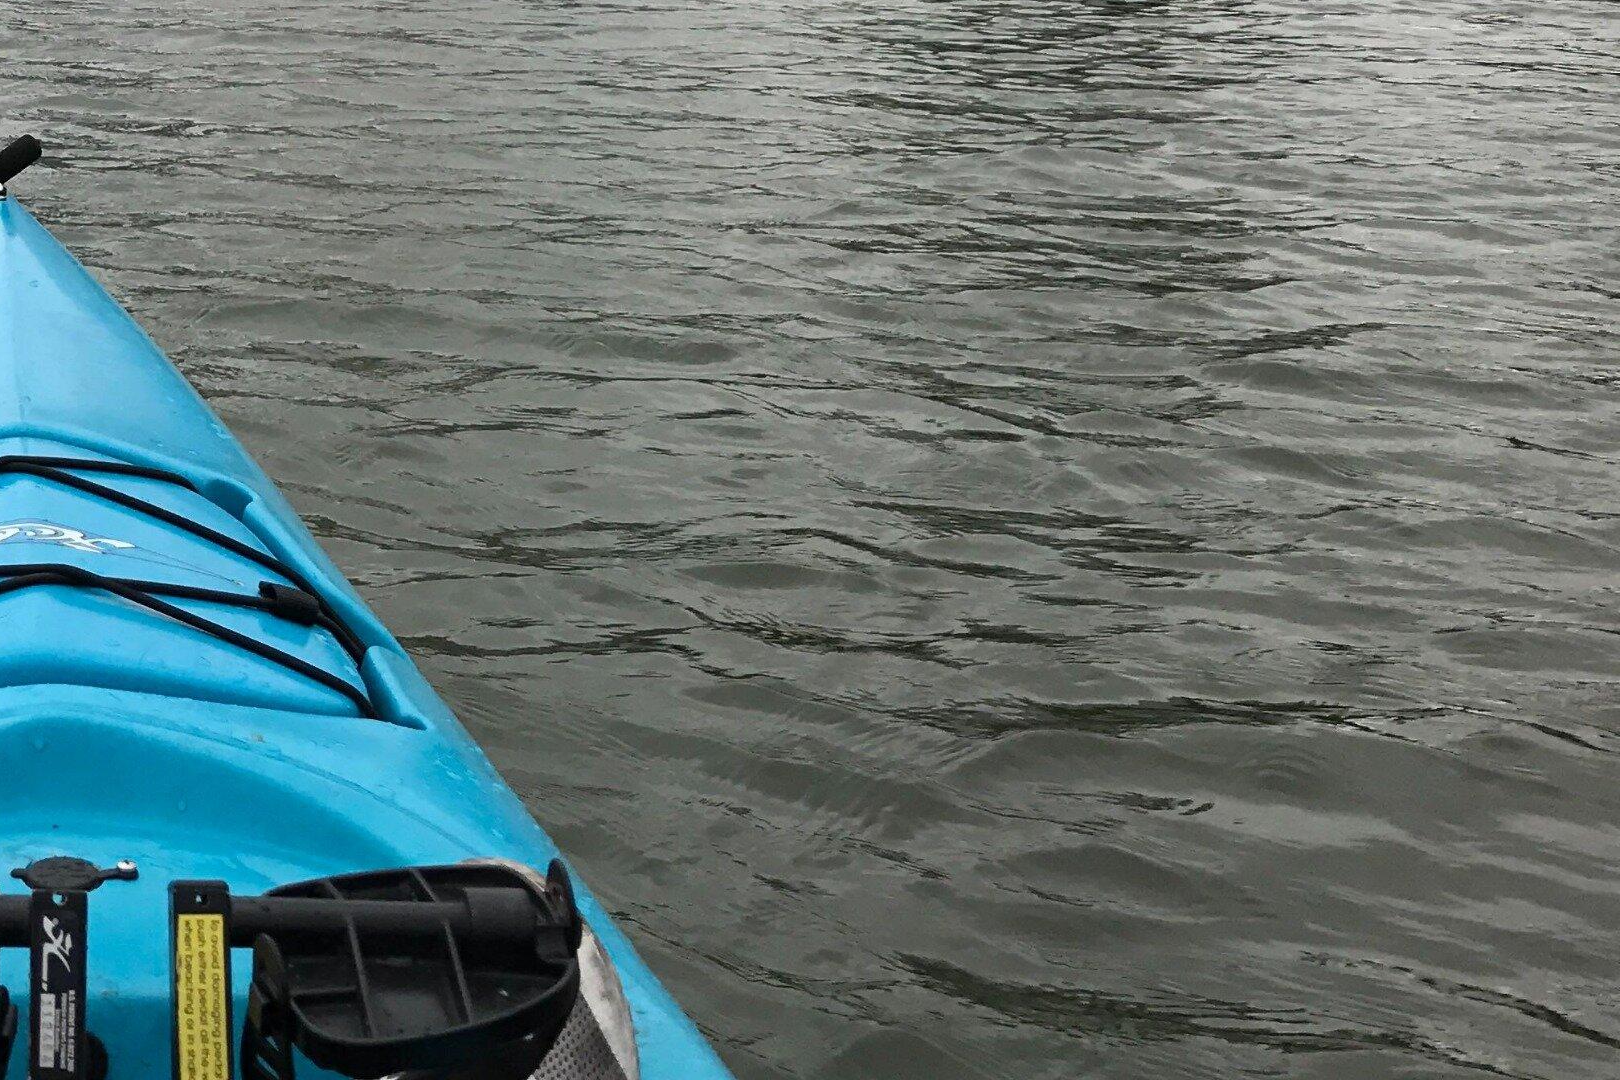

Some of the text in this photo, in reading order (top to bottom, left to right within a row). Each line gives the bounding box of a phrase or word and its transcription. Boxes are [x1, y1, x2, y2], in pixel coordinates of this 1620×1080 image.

[198, 952, 206, 985] either
[211, 935, 220, 969] avoid
[183, 955, 193, 1014] beaching
[198, 989, 207, 1024] pedal
[211, 973, 221, 1037] damaging
